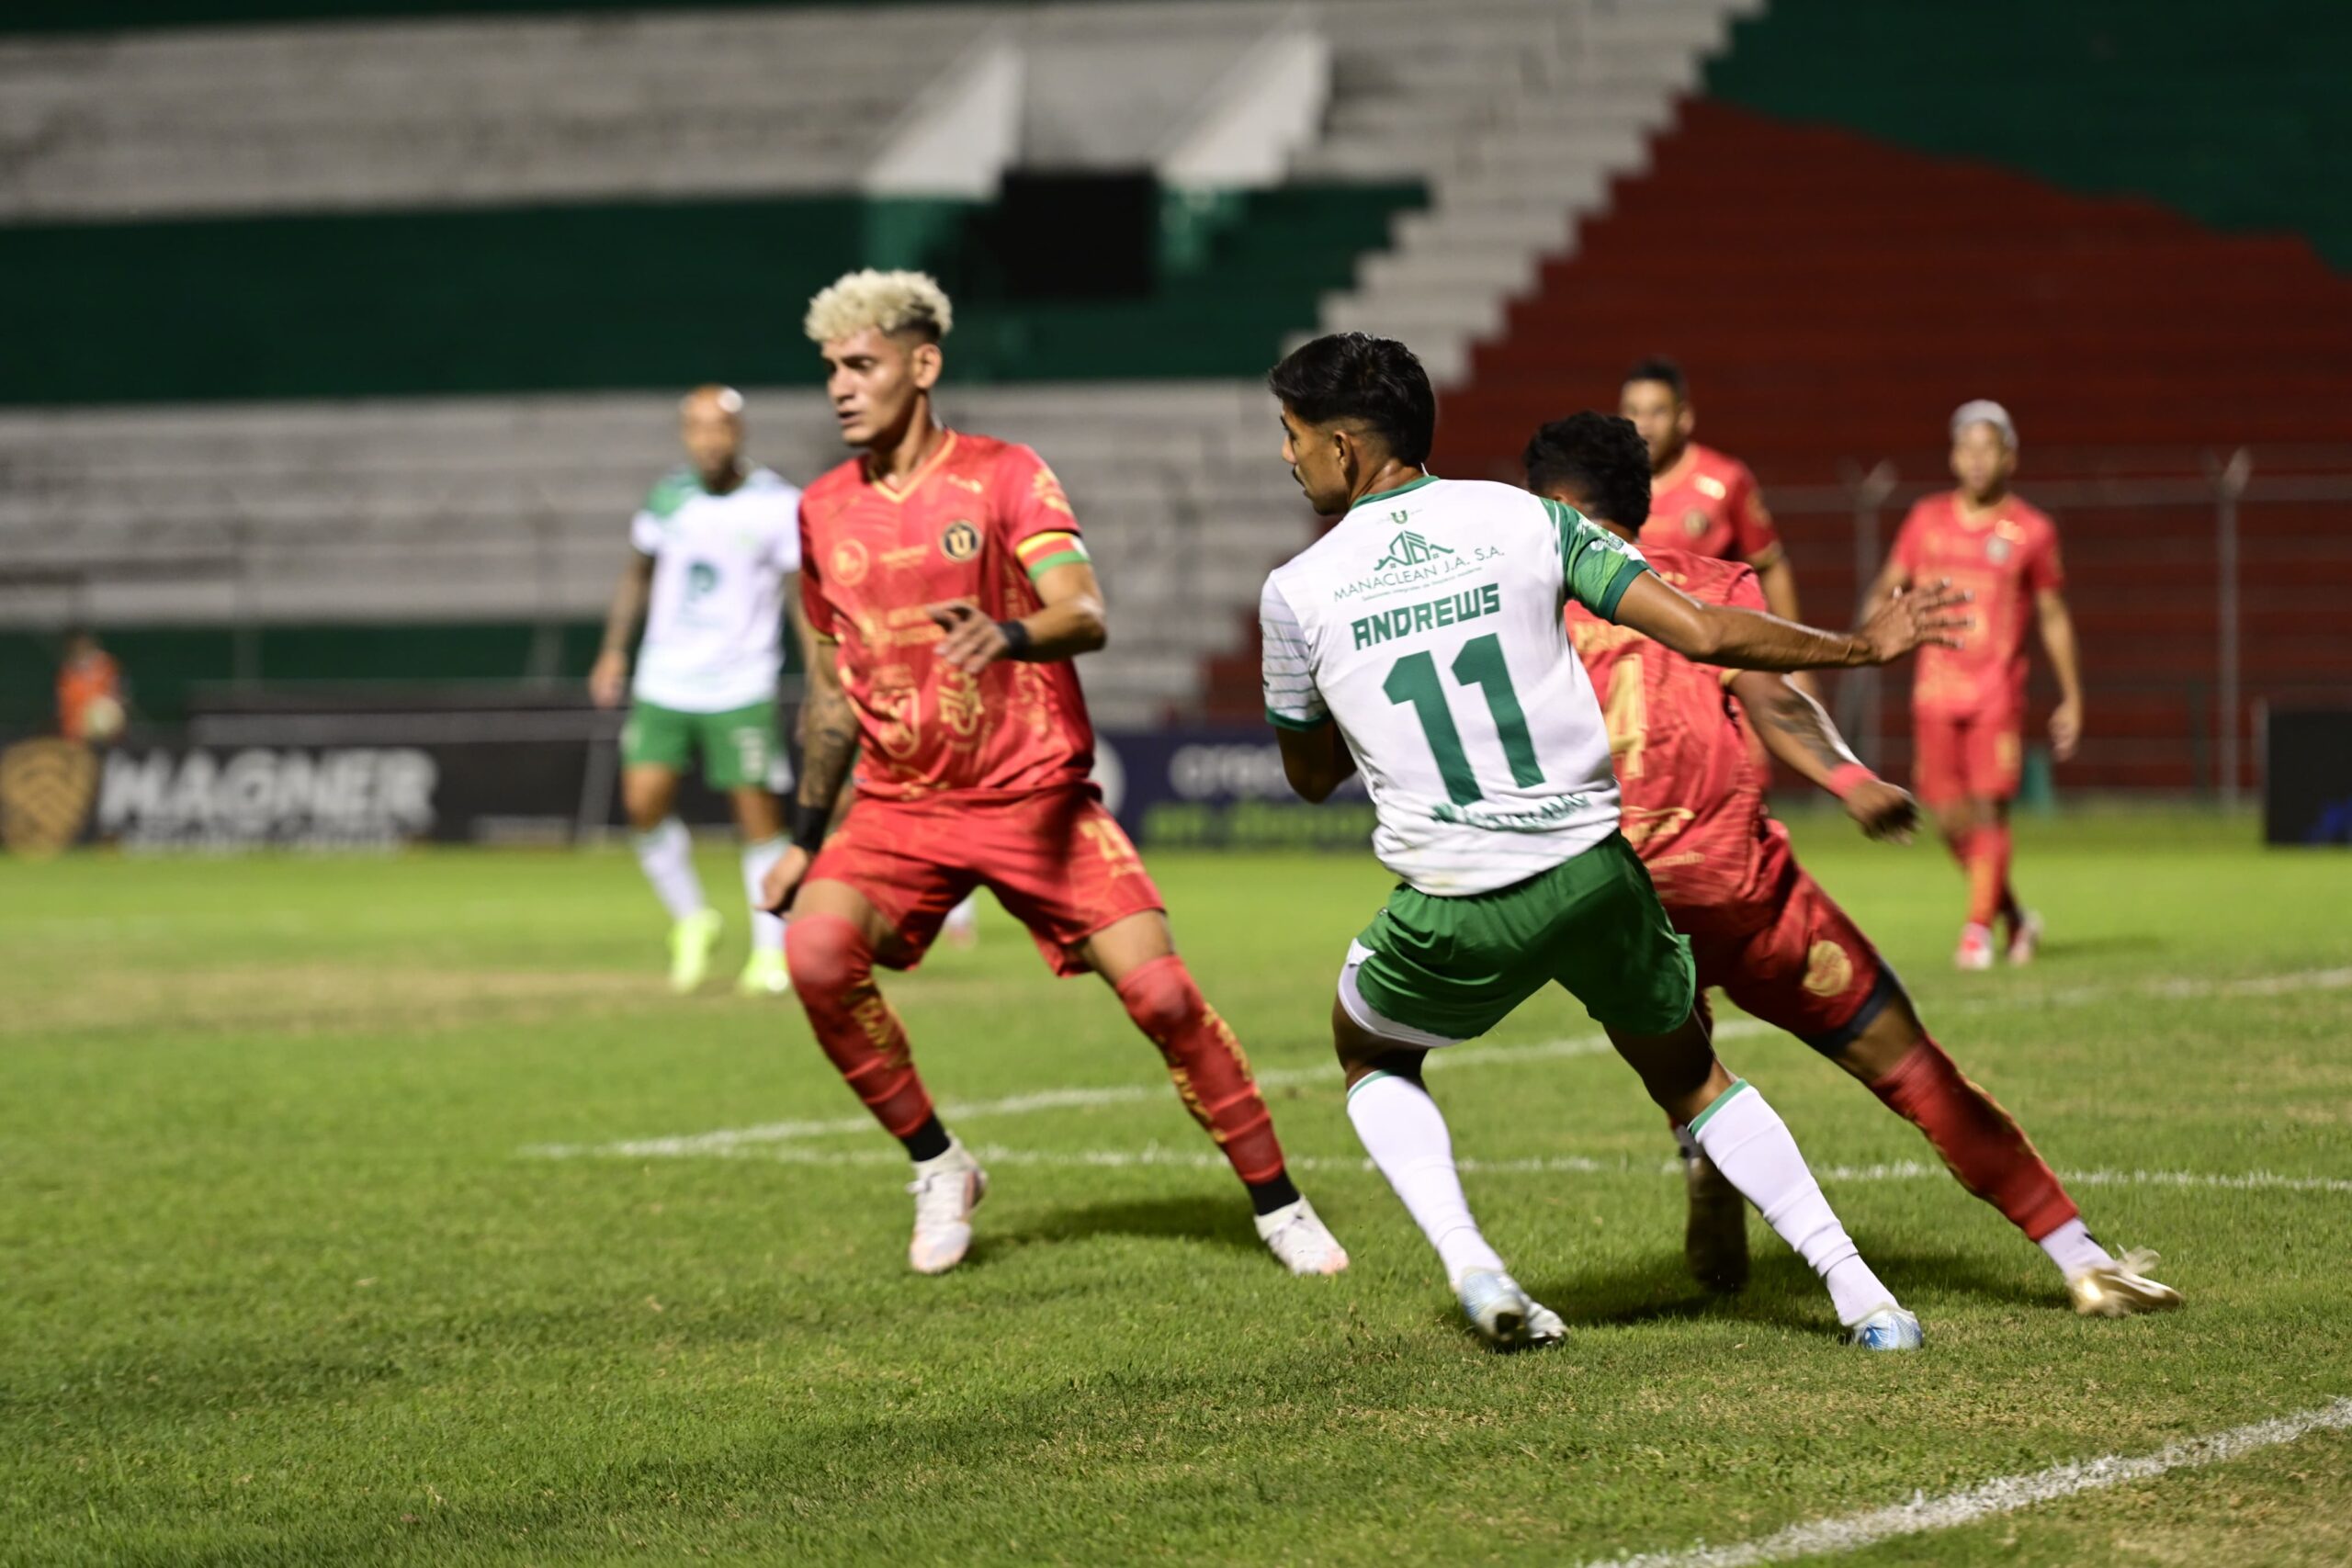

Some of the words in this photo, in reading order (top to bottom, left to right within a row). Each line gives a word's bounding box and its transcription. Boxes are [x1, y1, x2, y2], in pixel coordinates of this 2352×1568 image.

[1334, 564, 1437, 602] MANACLEAN
[1444, 556, 1471, 573] J.A.
[1474, 546, 1505, 561] S.A.
[1351, 582, 1499, 650] ANDREWS
[1382, 632, 1546, 807] 11
